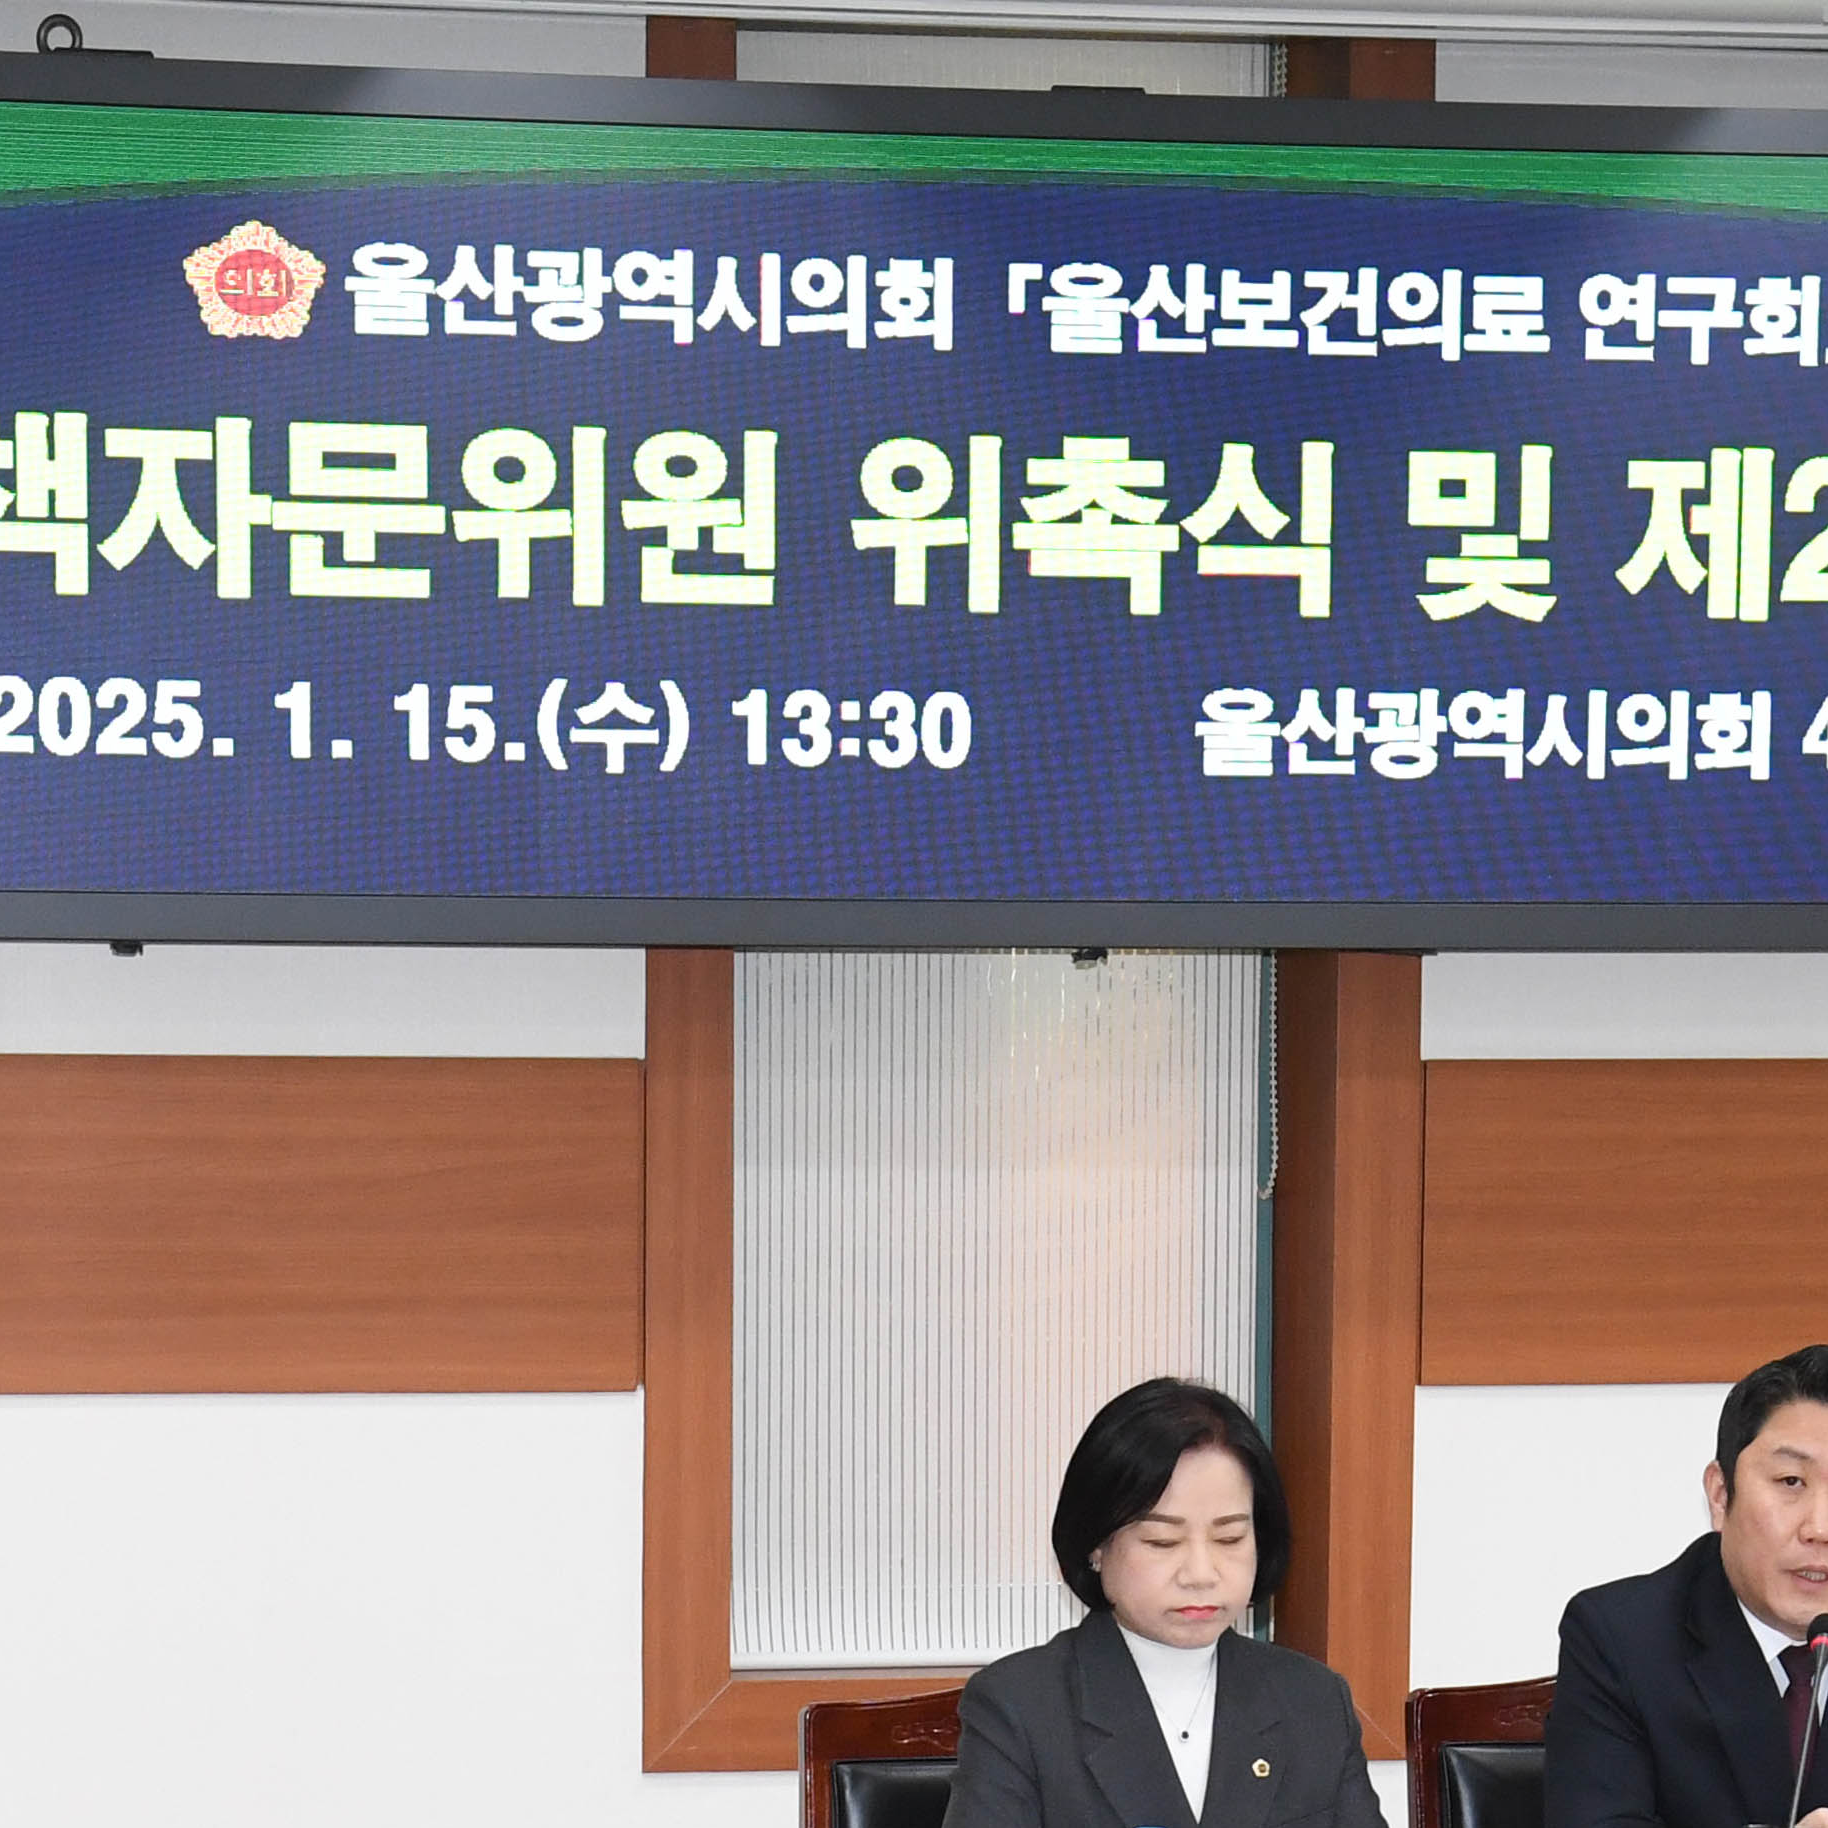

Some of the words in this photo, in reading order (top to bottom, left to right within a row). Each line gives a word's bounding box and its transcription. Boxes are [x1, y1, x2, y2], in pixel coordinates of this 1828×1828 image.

[219, 268, 287, 297] 의회
[345, 242, 955, 351] 울산광역시의회
[1009, 262, 1551, 362] 「울산보건의료
[850, 435, 1335, 618] 위촉식
[1407, 444, 1558, 623] 및
[274, 681, 353, 759] 1.
[393, 678, 690, 775] 15.(수)
[731, 688, 972, 769] 13:30
[1194, 687, 1772, 781] 울산광역시의회
